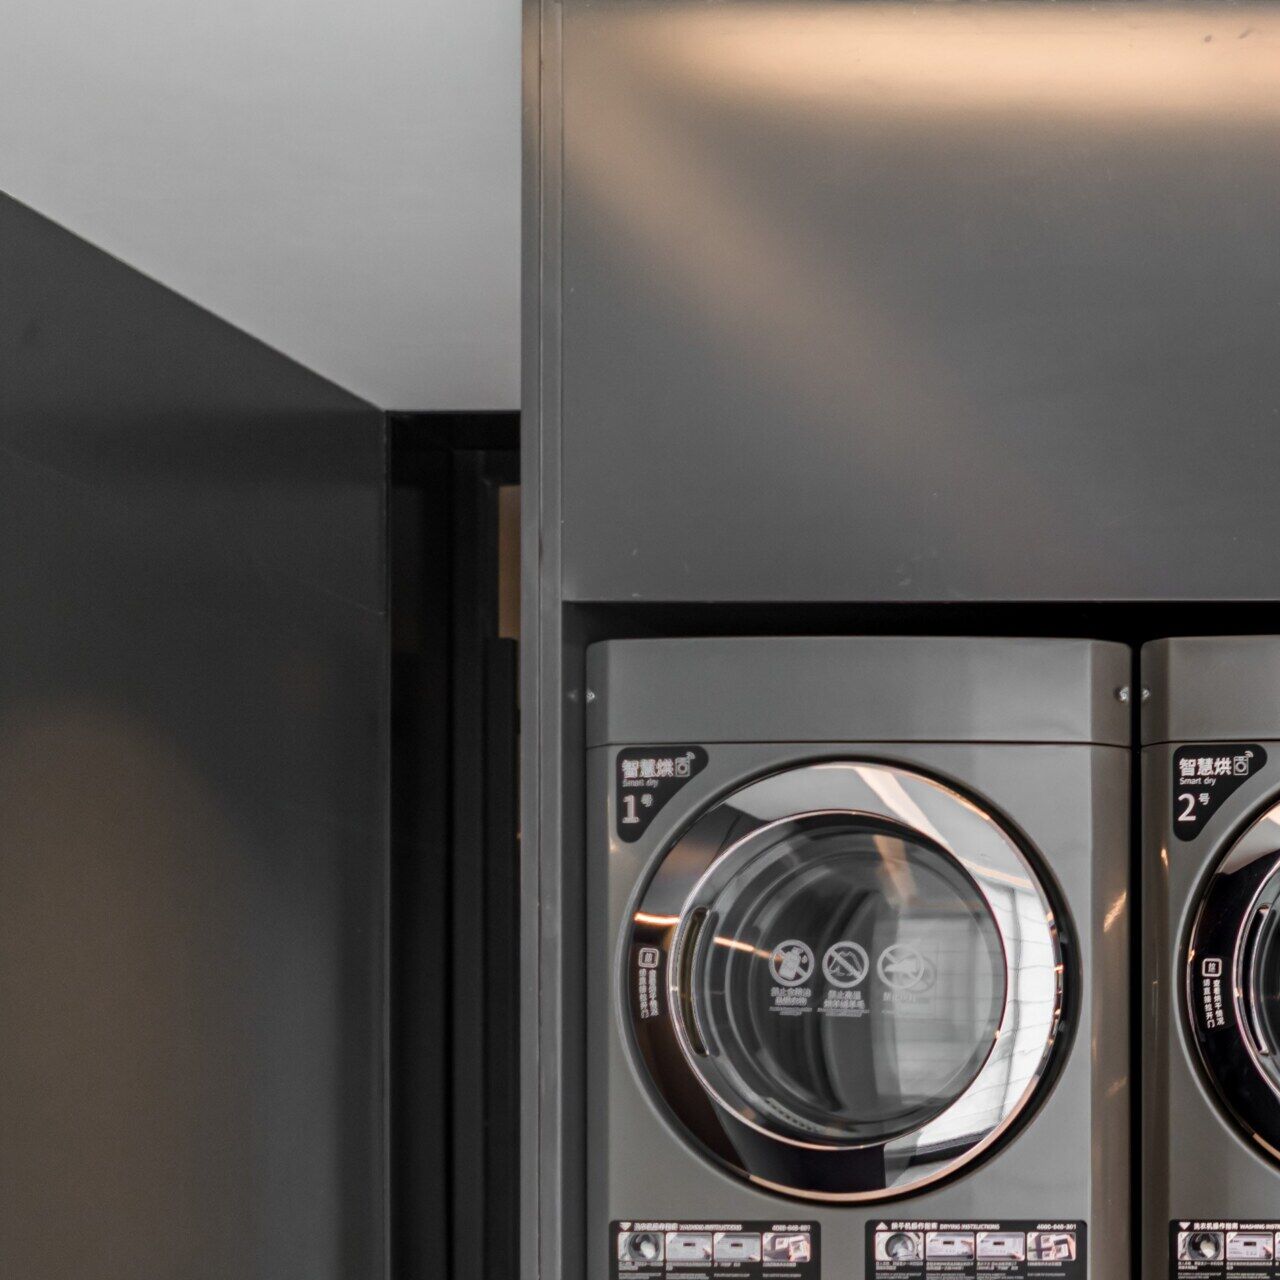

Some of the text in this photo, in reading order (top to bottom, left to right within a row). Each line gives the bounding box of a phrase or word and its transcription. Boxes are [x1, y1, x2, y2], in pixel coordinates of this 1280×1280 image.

[1179, 757, 1232, 776] 智慧烘
[1180, 777, 1216, 786] Smart dry
